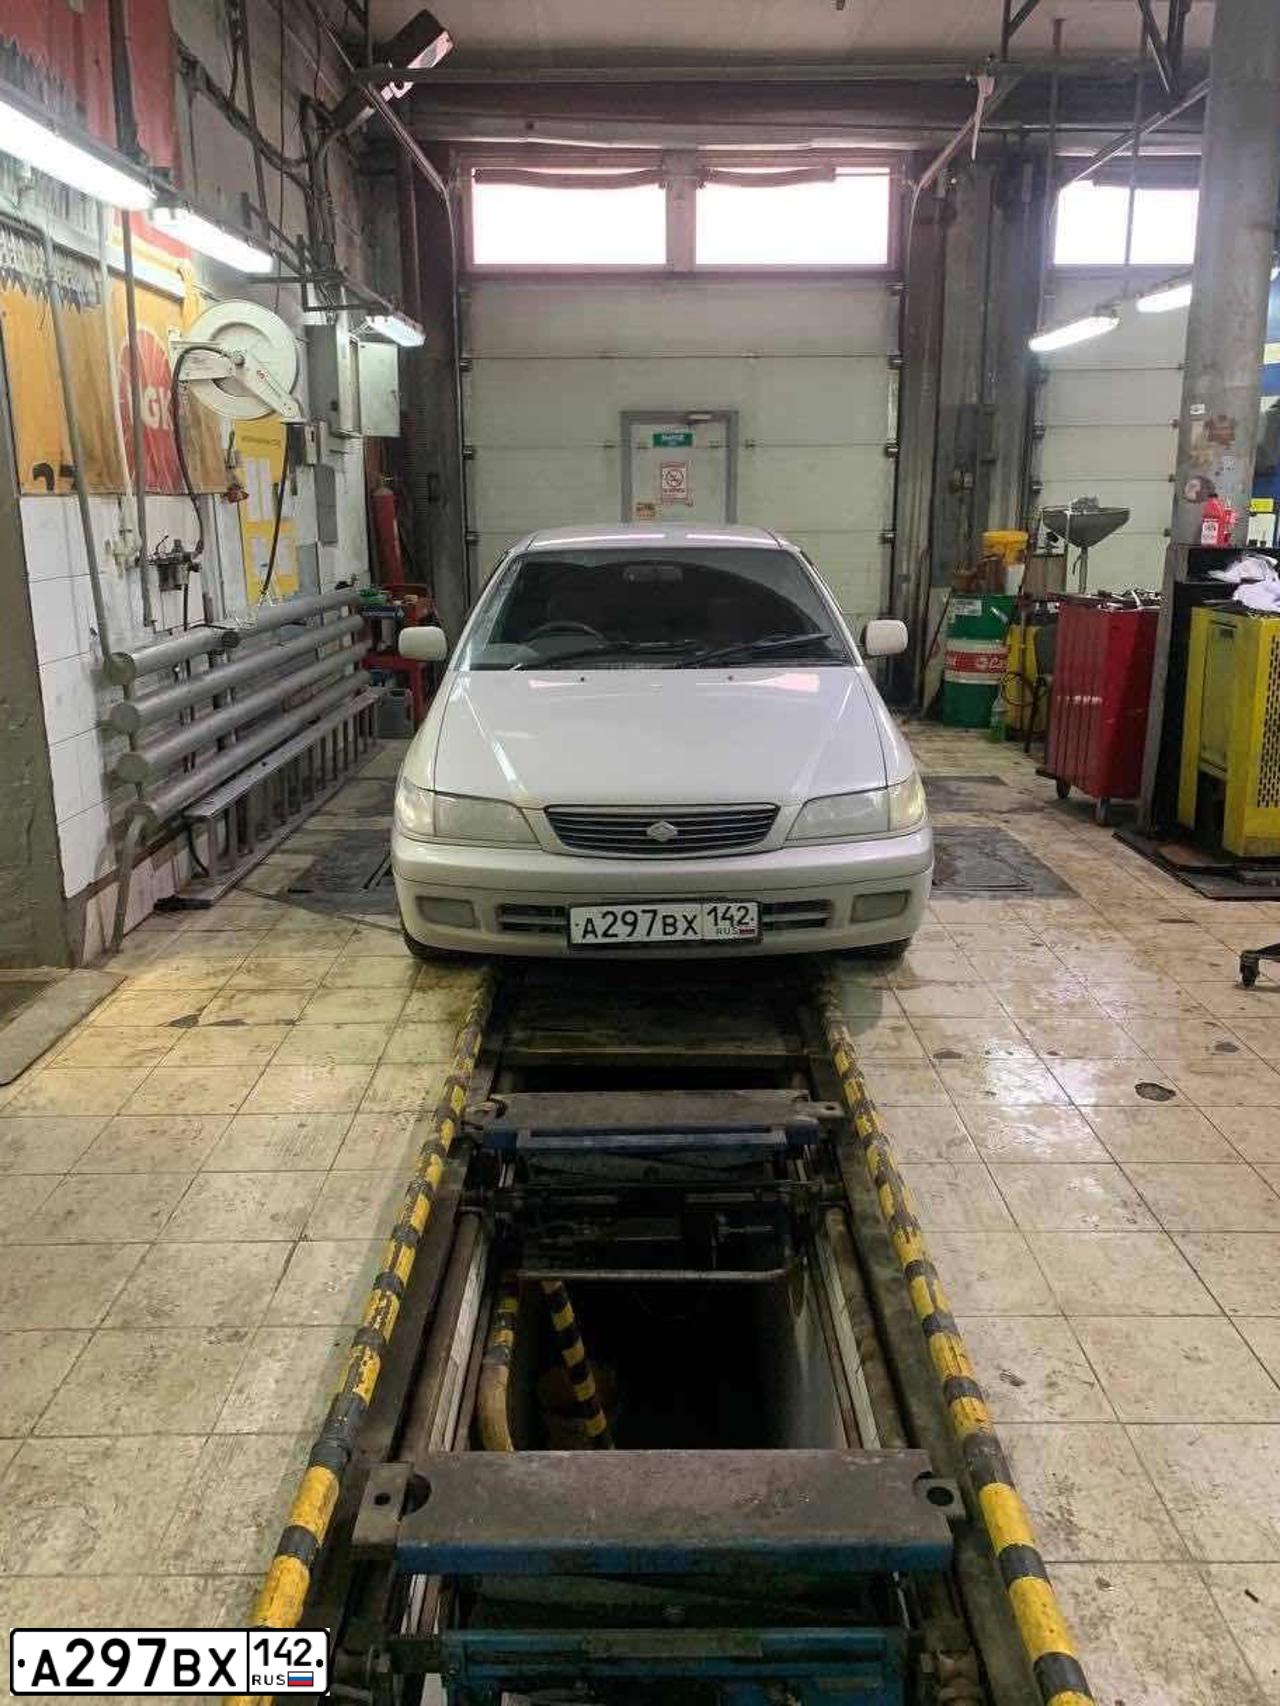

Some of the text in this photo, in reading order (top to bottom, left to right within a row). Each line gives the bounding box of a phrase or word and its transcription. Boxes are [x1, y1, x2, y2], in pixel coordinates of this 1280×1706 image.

[582, 905, 750, 939] А297ВХ 142
[716, 927, 739, 935] RUS
